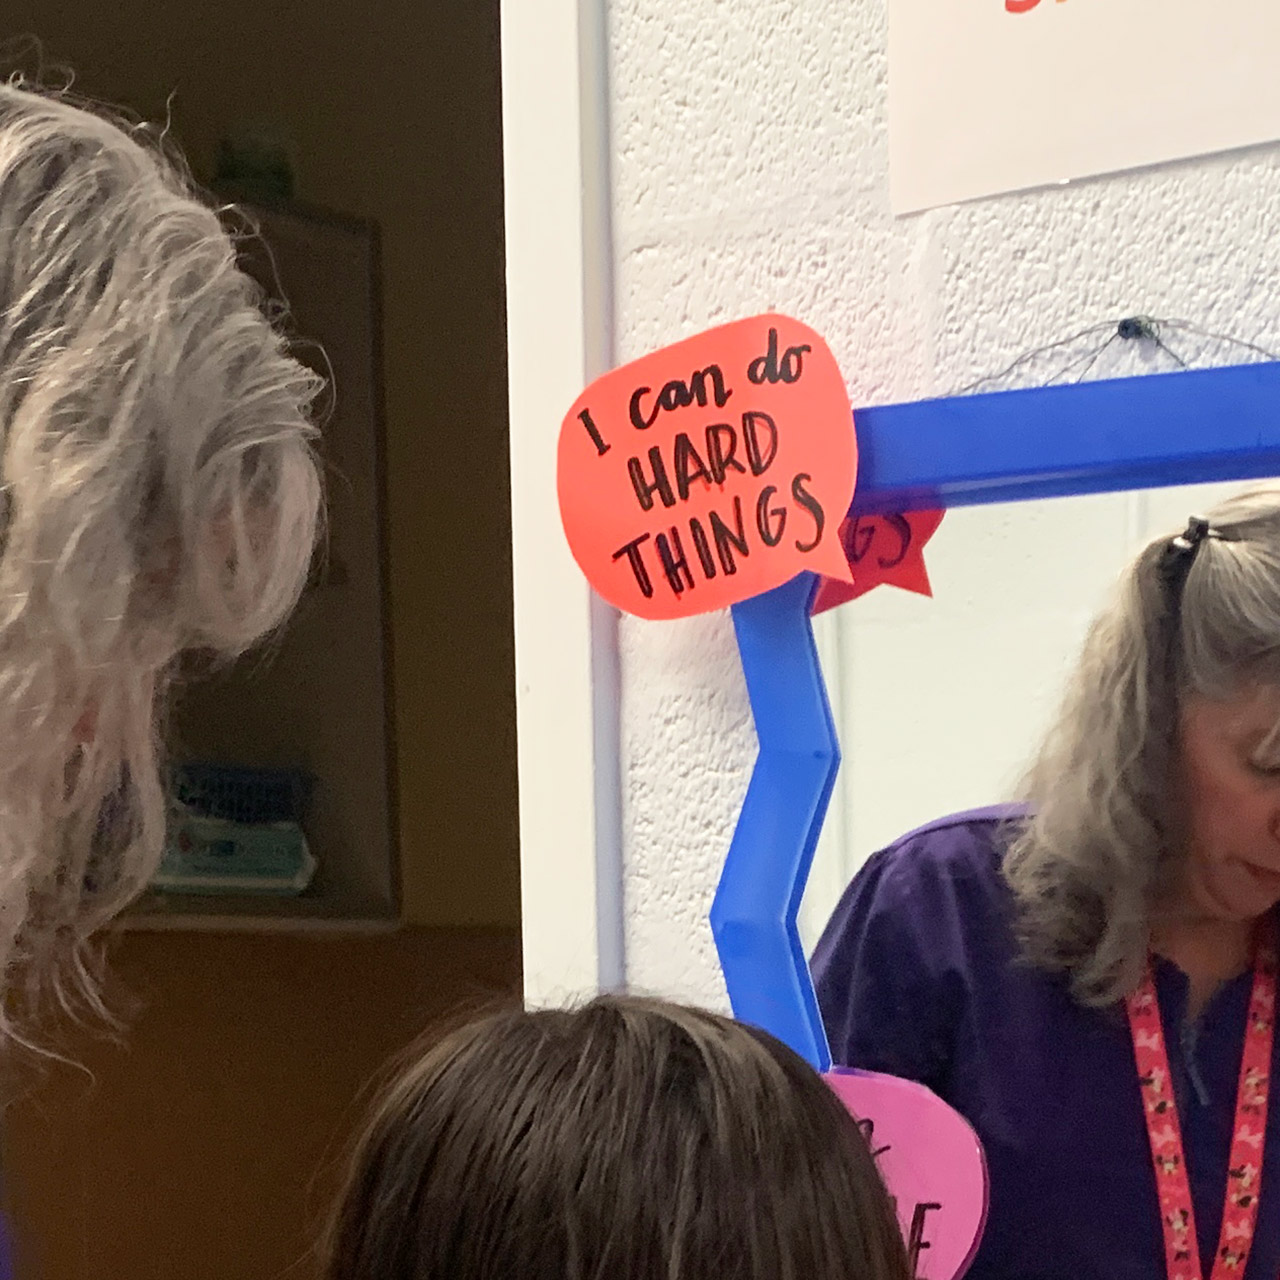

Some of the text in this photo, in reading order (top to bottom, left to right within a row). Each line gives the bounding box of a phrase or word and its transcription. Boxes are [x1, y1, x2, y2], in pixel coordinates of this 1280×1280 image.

[577, 328, 812, 455] I can do
[627, 411, 779, 513] HARD
[612, 472, 825, 600] THINGS
